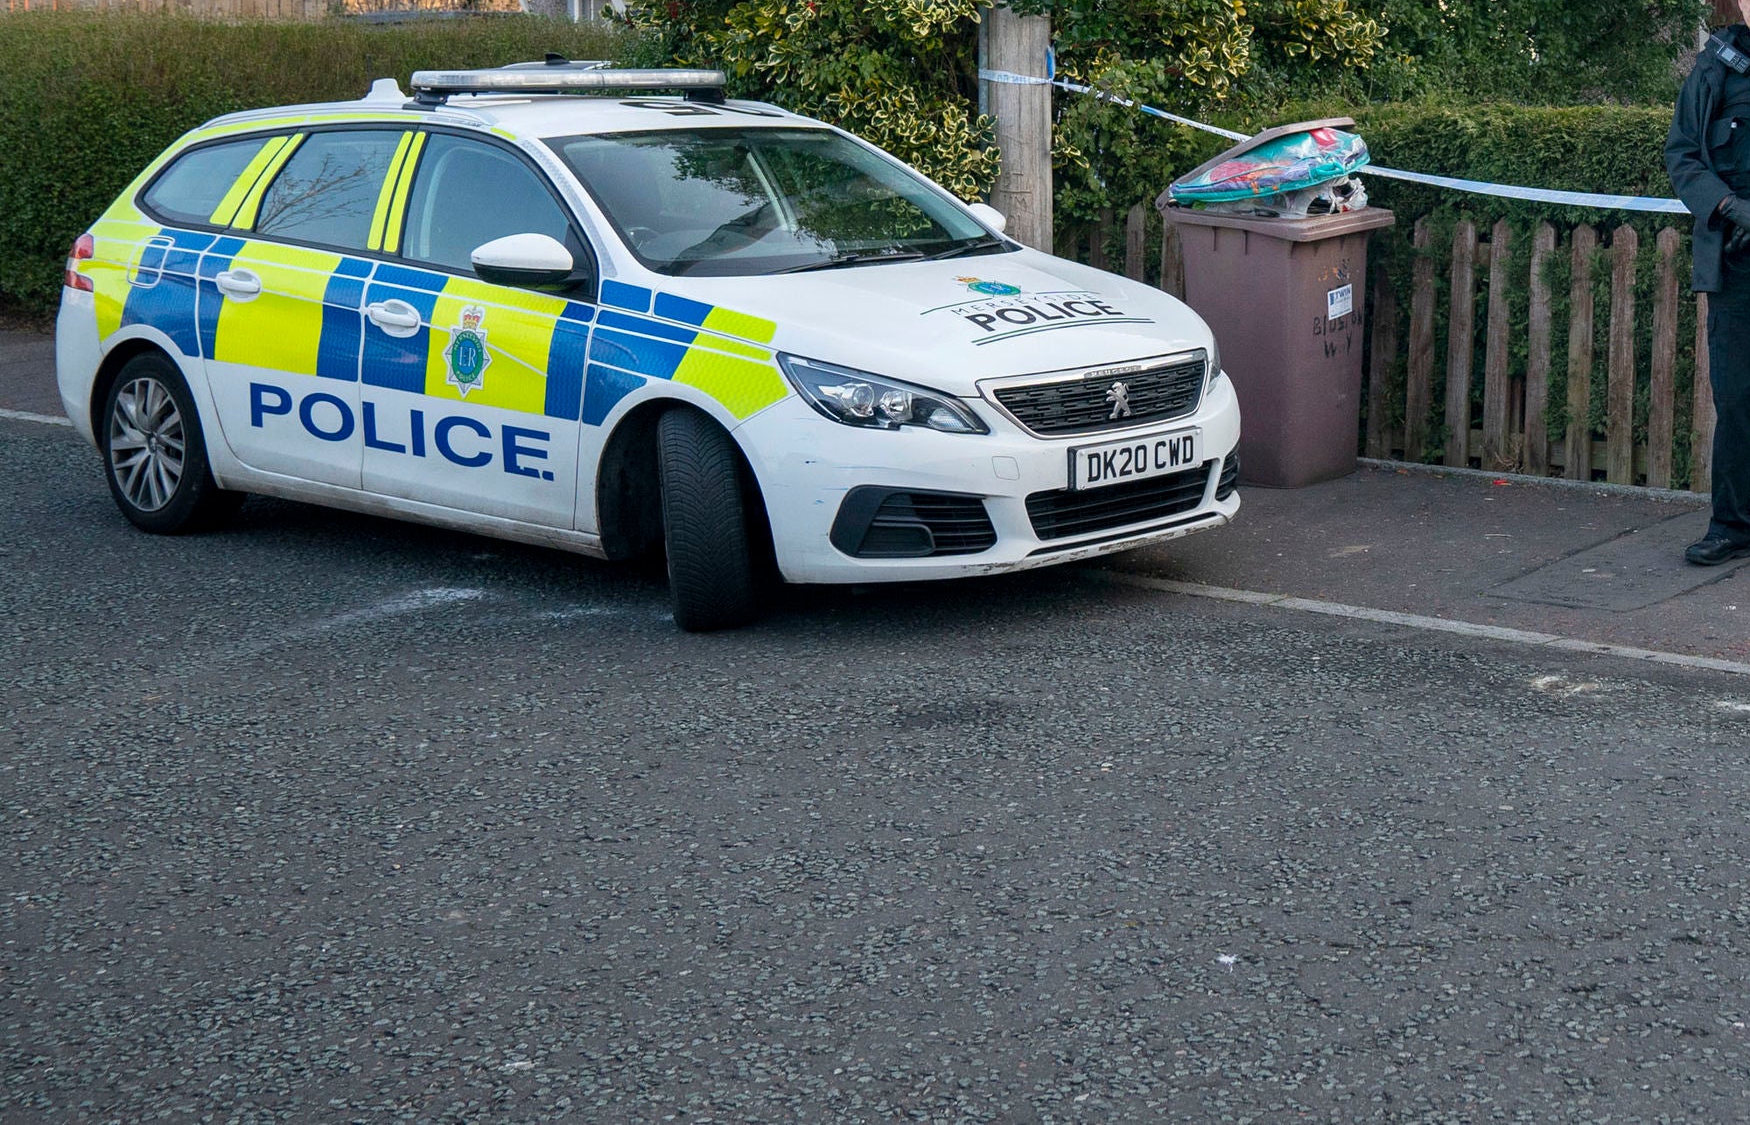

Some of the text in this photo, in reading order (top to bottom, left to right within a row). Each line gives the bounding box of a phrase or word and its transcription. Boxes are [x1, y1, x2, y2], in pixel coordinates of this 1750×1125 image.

[965, 300, 1124, 332] POLICE
[249, 382, 554, 481] POLICE
[1087, 435, 1194, 483] DK20 CWD
